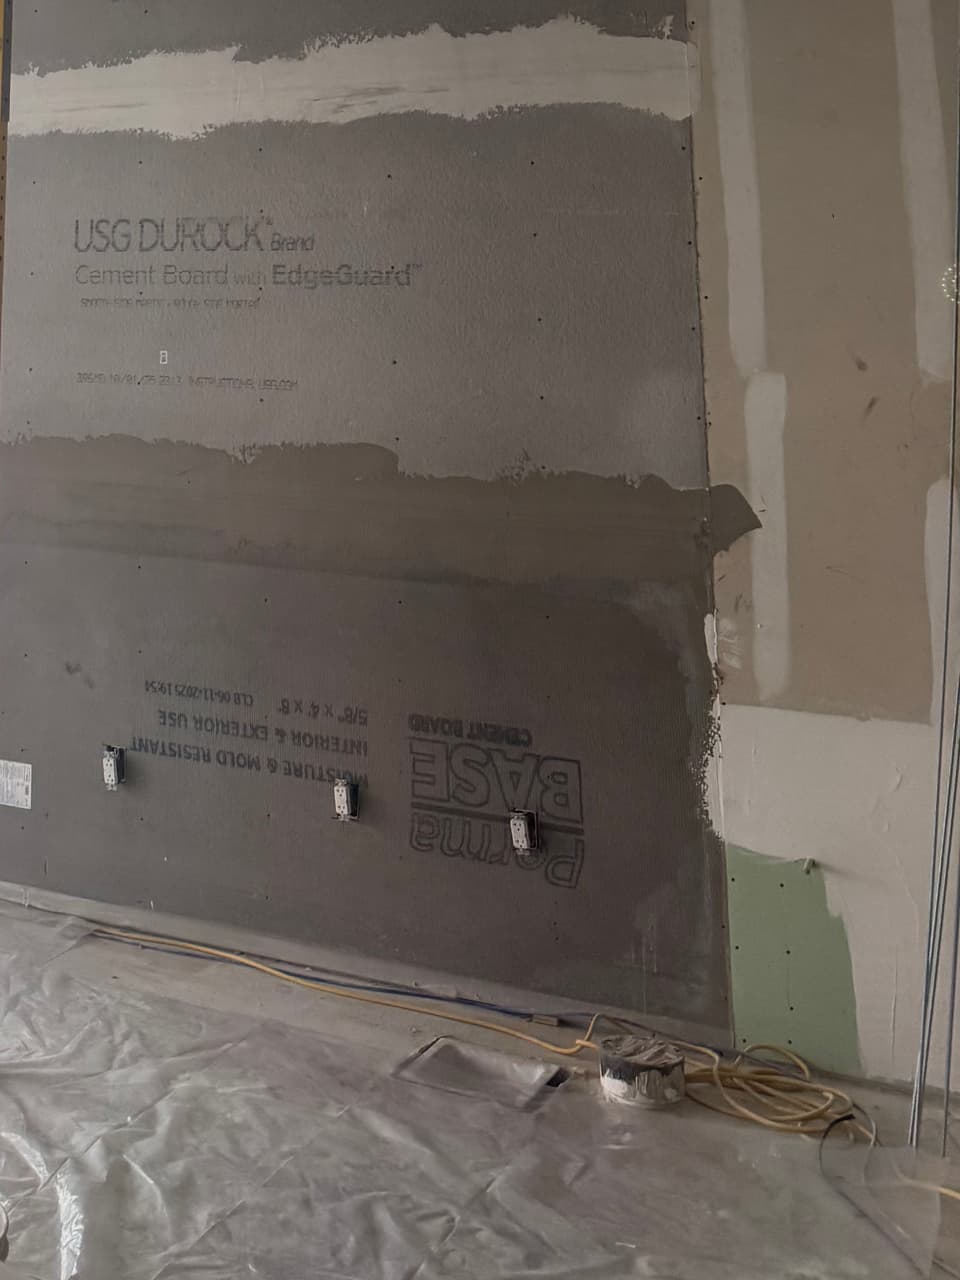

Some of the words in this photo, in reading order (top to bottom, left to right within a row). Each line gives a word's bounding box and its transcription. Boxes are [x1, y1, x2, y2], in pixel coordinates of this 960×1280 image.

[74, 218, 131, 253] USG
[270, 232, 315, 252] Brand
[74, 264, 156, 286] Cement
[162, 264, 229, 286] Board
[233, 267, 266, 286] with
[175, 683, 232, 705] 06-11-2025
[233, 691, 254, 707] CLB
[157, 709, 188, 727] USE
[192, 715, 268, 742] EXTERIOR
[408, 713, 464, 739] BOARD
[274, 727, 288, 743] &
[291, 731, 368, 756] INTERIOR
[129, 735, 211, 763] RESISTANT
[216, 749, 261, 771] MOLD
[266, 762, 277, 775] &
[408, 736, 584, 825] BASE
